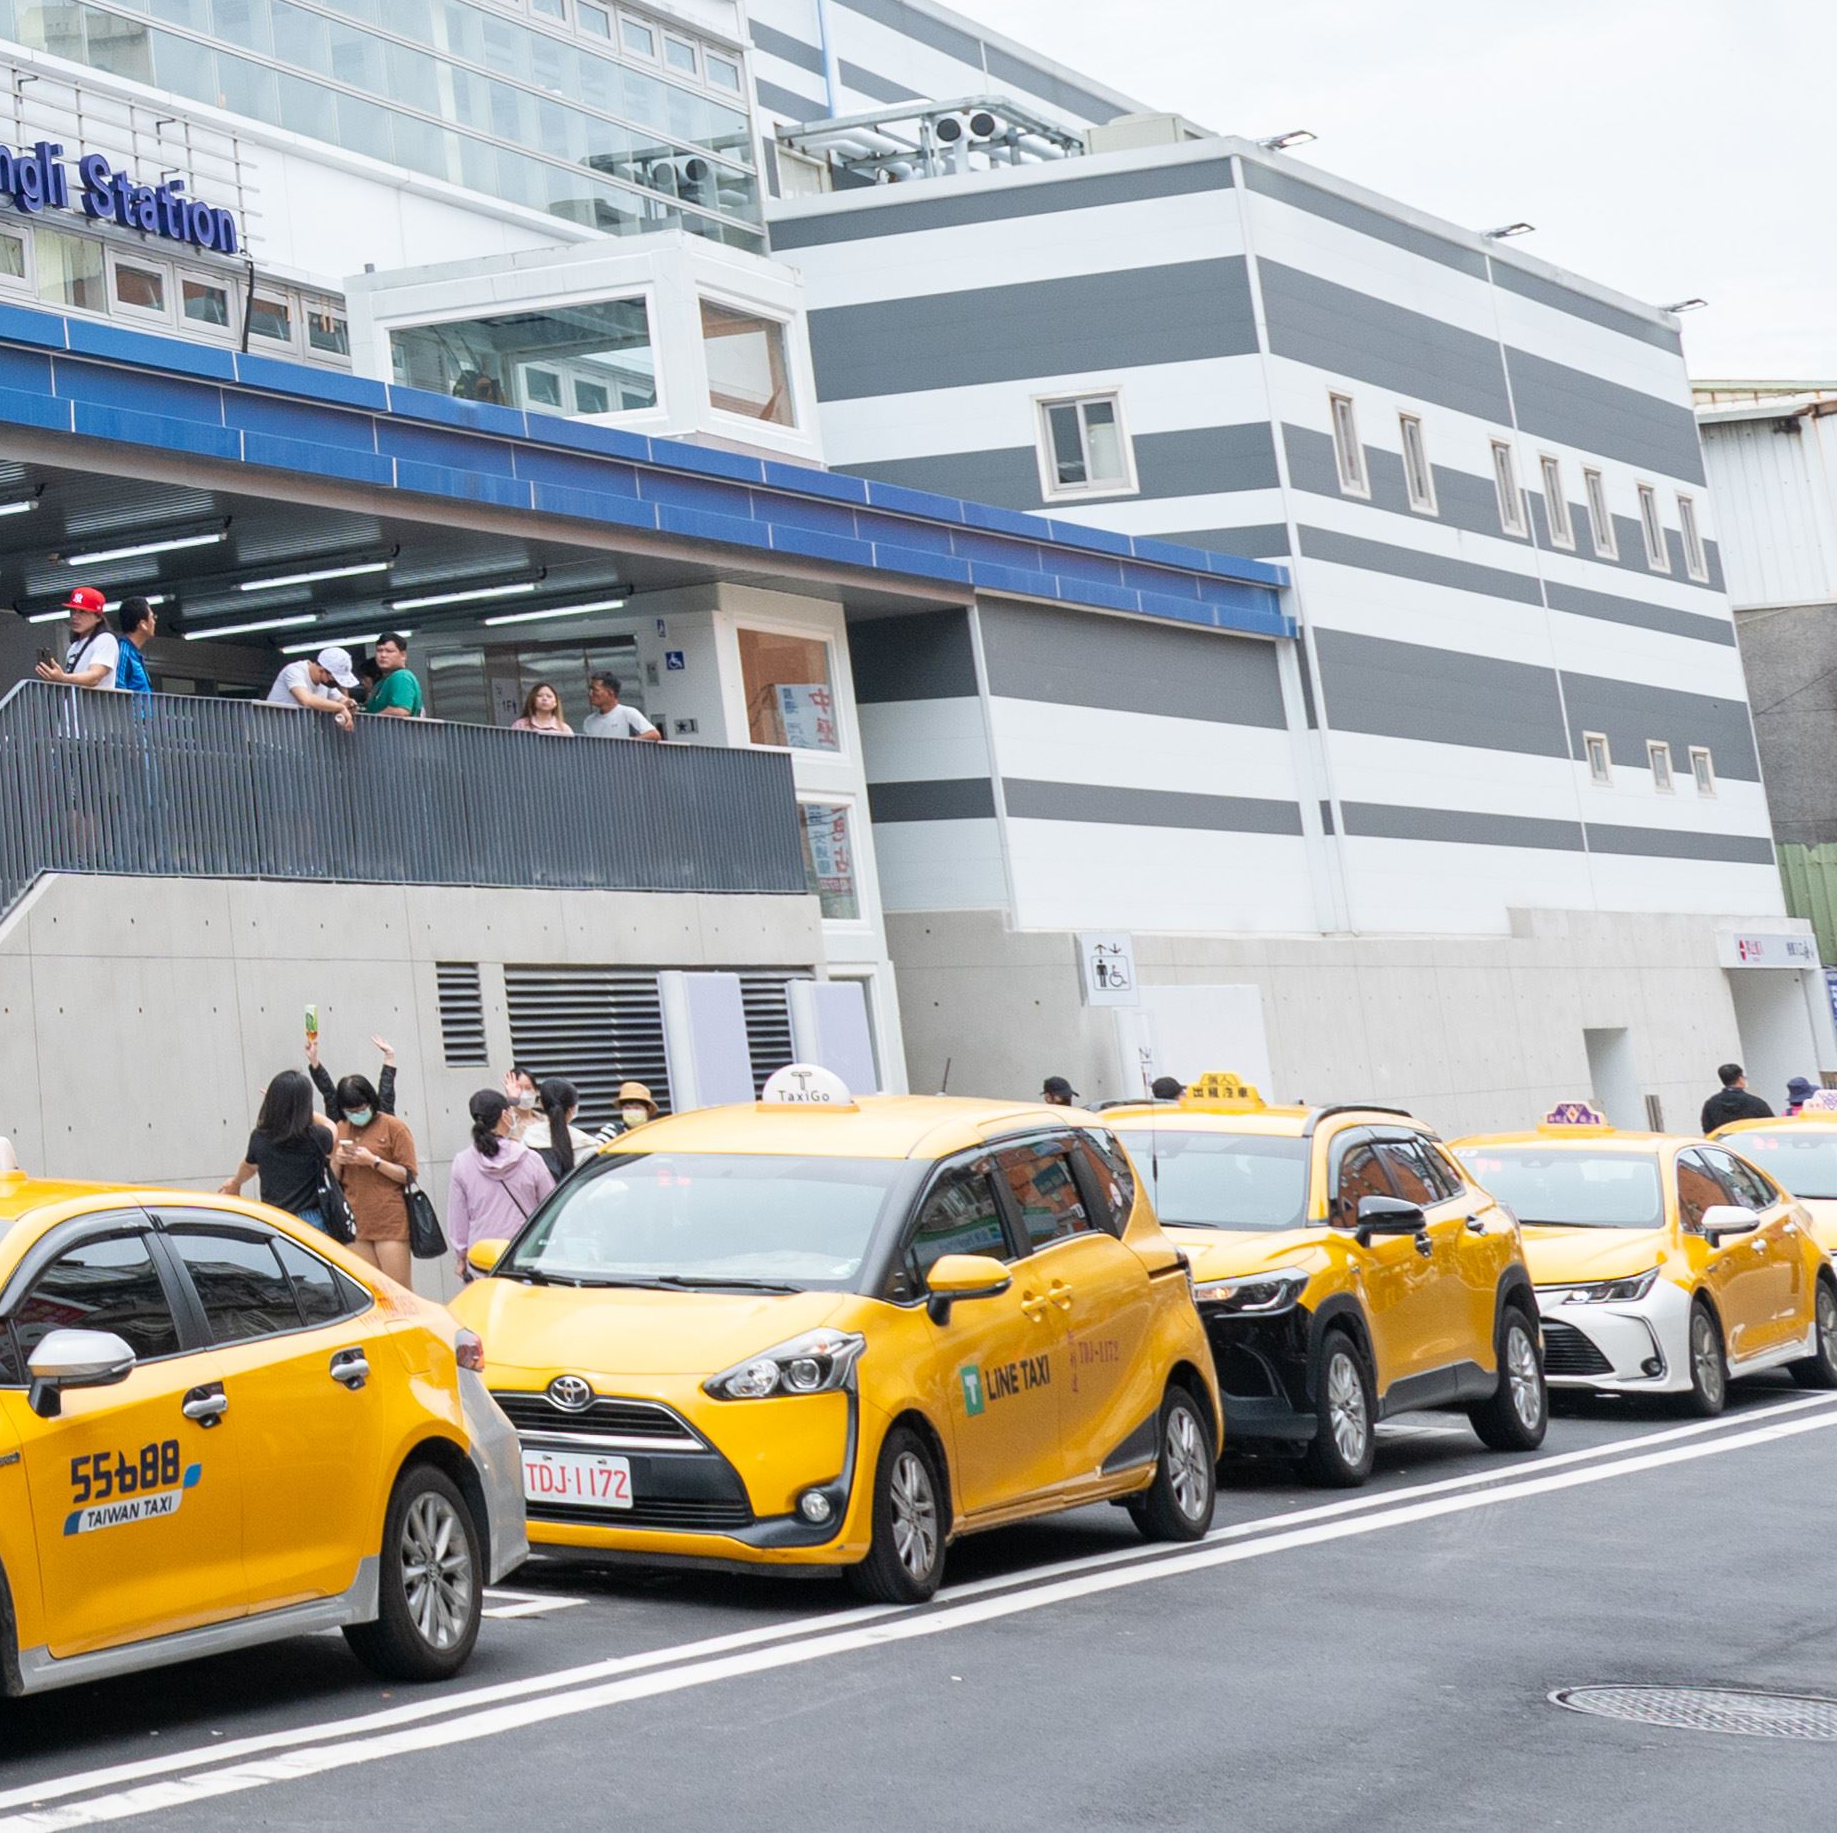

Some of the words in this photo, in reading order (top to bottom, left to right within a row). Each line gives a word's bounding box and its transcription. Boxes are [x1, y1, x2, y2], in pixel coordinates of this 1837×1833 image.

[80, 154, 237, 254] Station
[778, 1090, 830, 1102] TaxiGo
[985, 1363, 1019, 1401] LINE
[1019, 1354, 1051, 1390] TAXI
[70, 1439, 180, 1504] 55688
[87, 1503, 140, 1529] TAIWAN
[144, 1496, 173, 1516] TAXI
